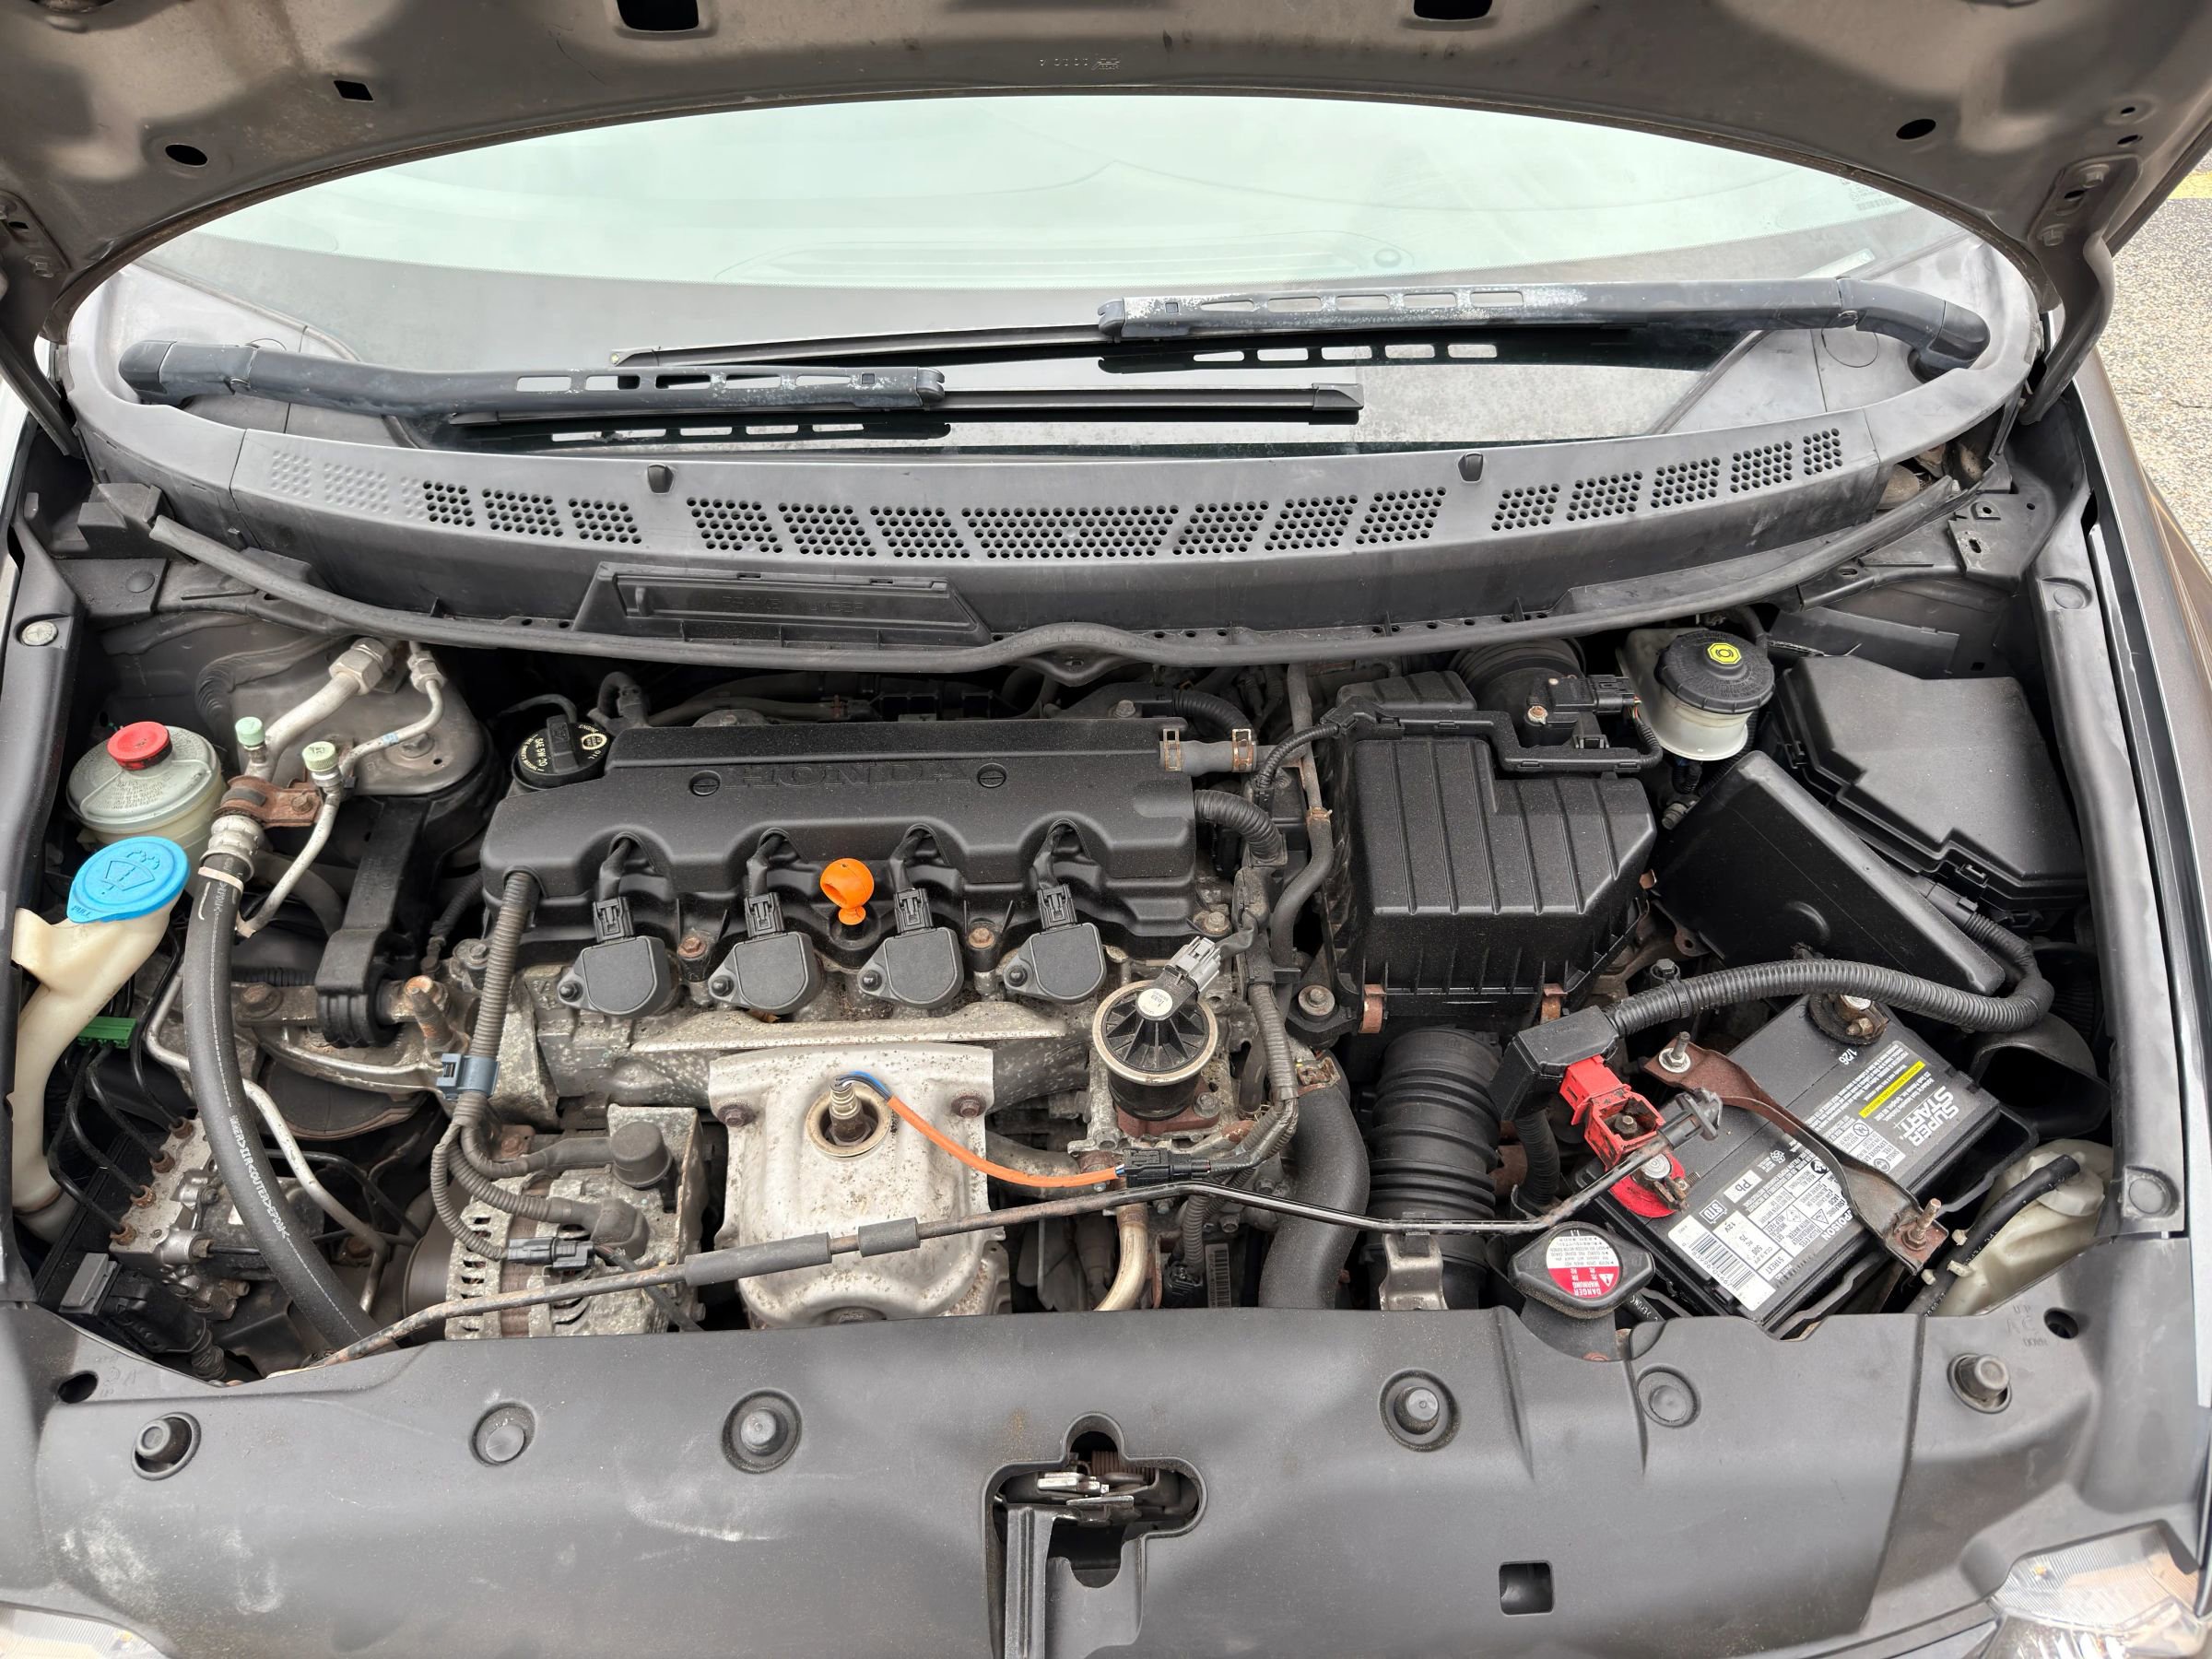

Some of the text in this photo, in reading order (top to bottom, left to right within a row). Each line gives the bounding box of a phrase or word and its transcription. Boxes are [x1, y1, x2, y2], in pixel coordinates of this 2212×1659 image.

[724, 763, 972, 789] HONDA
[1838, 1047, 1858, 1065] 1/26
[1899, 1085, 1954, 1138] START
[1907, 1099, 1959, 1147] SUPER
[1867, 1139, 1888, 1158] EXPLOSIVE
[1733, 1178, 1752, 1193] Pb
[1827, 1194, 1839, 1206] ACID
[1702, 1201, 1724, 1221] STD
[1772, 1214, 1785, 1226] HELP
[1723, 1220, 1735, 1233] 12V
[1768, 1221, 1788, 1239] MEDICAL
[1797, 1218, 1810, 1230] WITH
[1737, 1233, 1748, 1242] 75
[1773, 1232, 1784, 1242] GET
[1790, 1221, 1816, 1246] IMMEDIATELY
[1797, 1227, 1821, 1248] FLUSH EYES
[1763, 1254, 1784, 1275] 51REXT
[1573, 1288, 1601, 1296] DANGER
